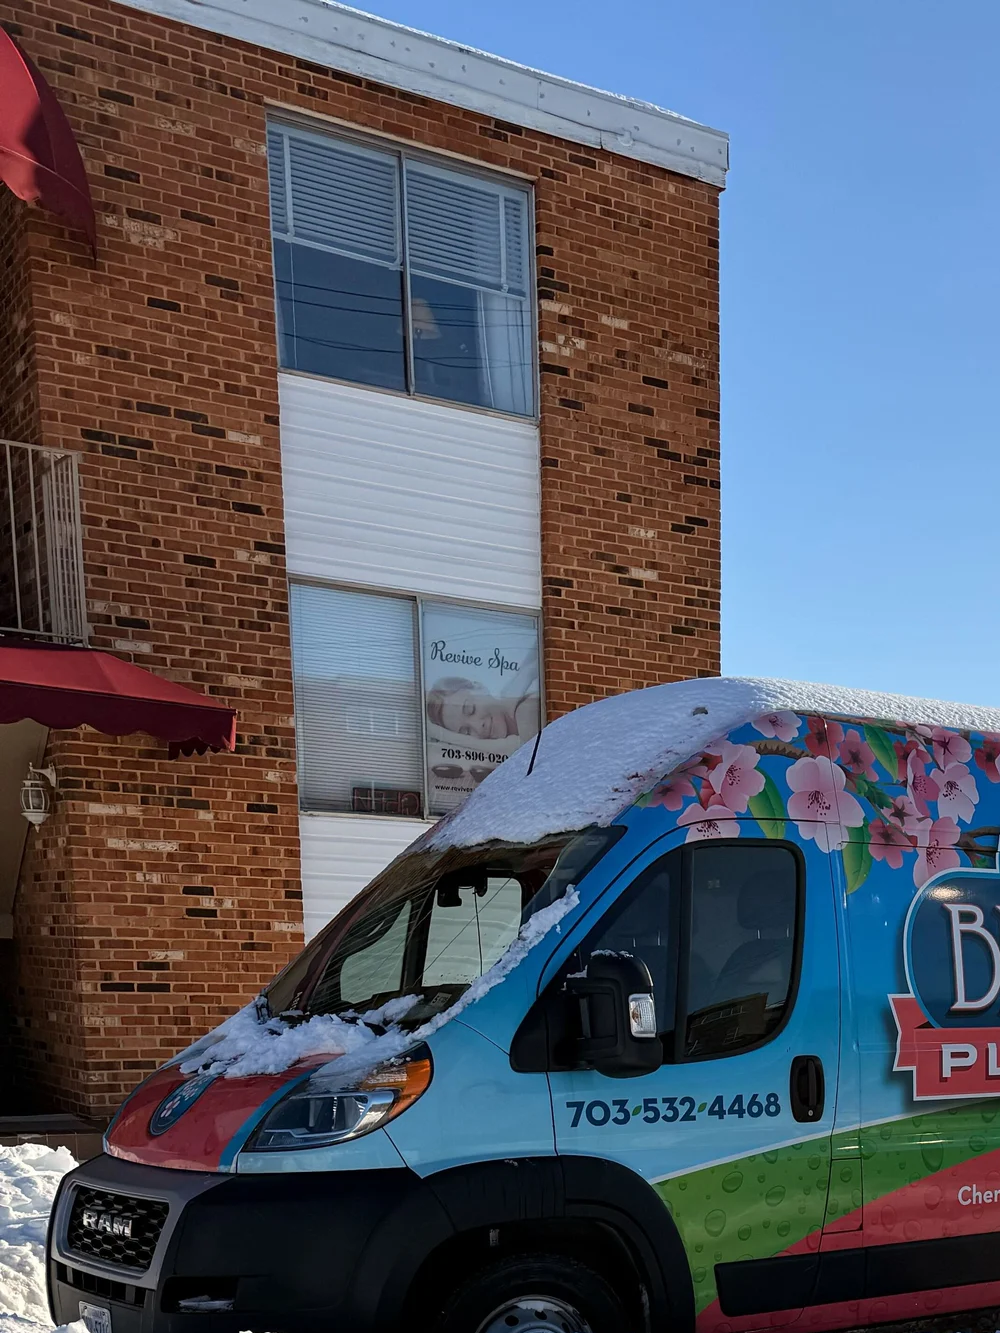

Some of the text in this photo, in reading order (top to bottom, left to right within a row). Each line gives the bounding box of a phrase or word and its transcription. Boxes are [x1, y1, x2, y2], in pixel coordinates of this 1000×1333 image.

[431, 640, 520, 676] Revive Spa
[441, 748, 509, 763] 703-896-020
[82, 1209, 132, 1238] RAM
